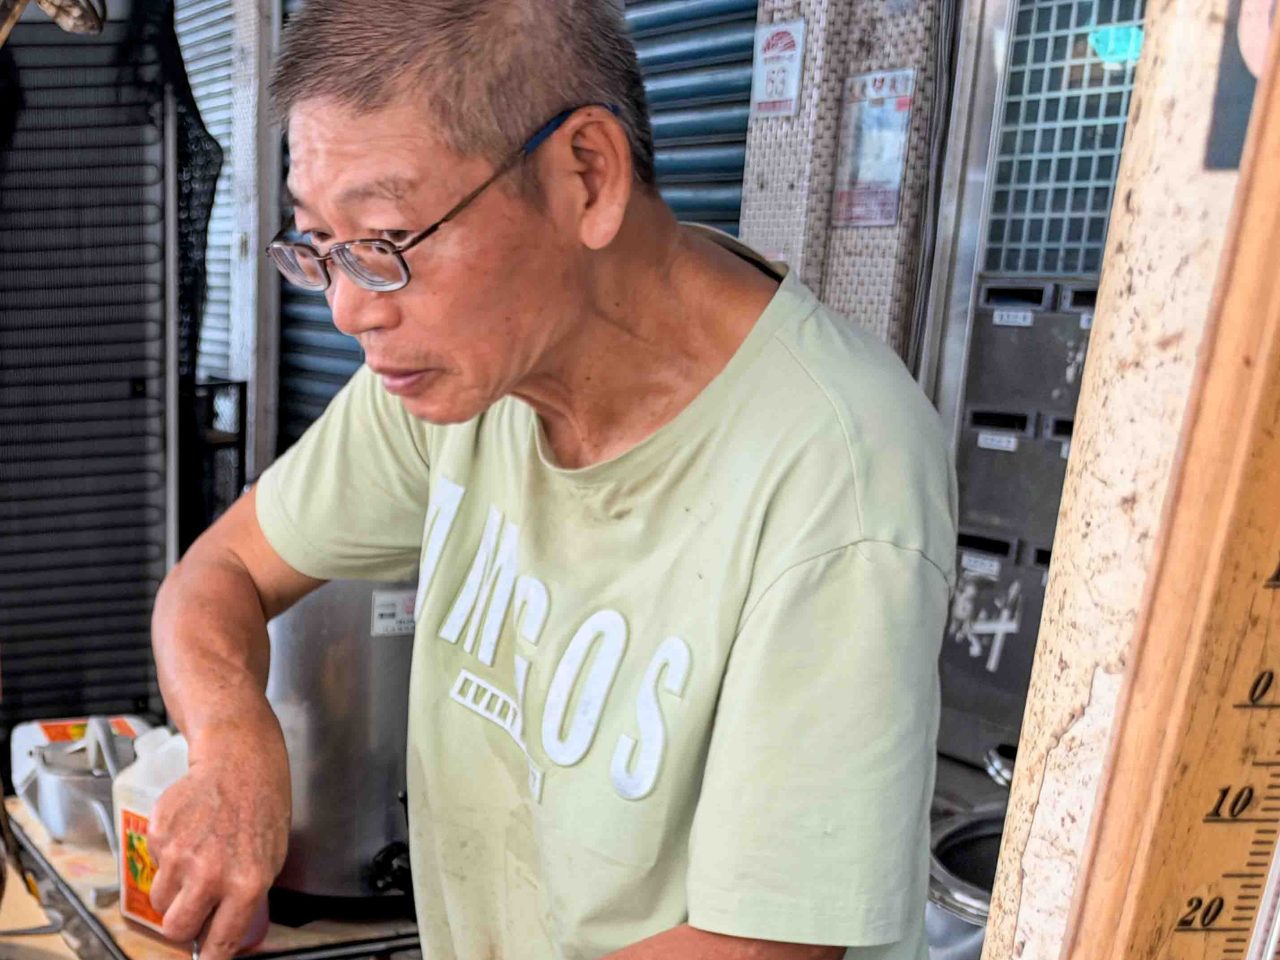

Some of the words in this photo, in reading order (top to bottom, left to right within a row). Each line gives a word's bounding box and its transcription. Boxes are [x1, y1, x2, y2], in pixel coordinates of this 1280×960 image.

[1249, 670, 1274, 704] 0
[1206, 785, 1255, 818] 10
[1177, 896, 1224, 928] 20
